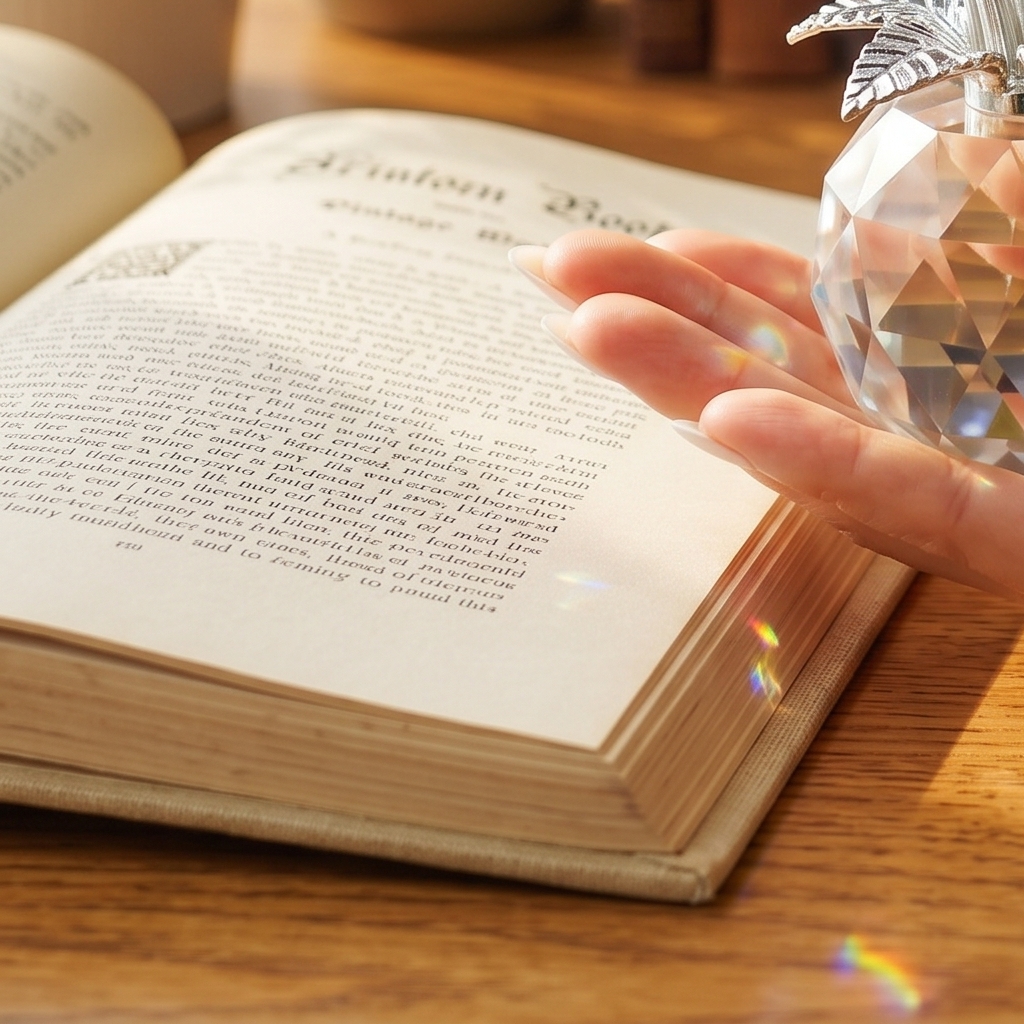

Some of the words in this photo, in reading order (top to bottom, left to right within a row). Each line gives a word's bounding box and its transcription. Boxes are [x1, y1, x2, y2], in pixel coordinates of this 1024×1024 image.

[192, 539, 233, 553] and
[240, 548, 262, 560] to
[359, 577, 382, 588] to
[203, 527, 246, 542] own
[392, 571, 416, 581] of
